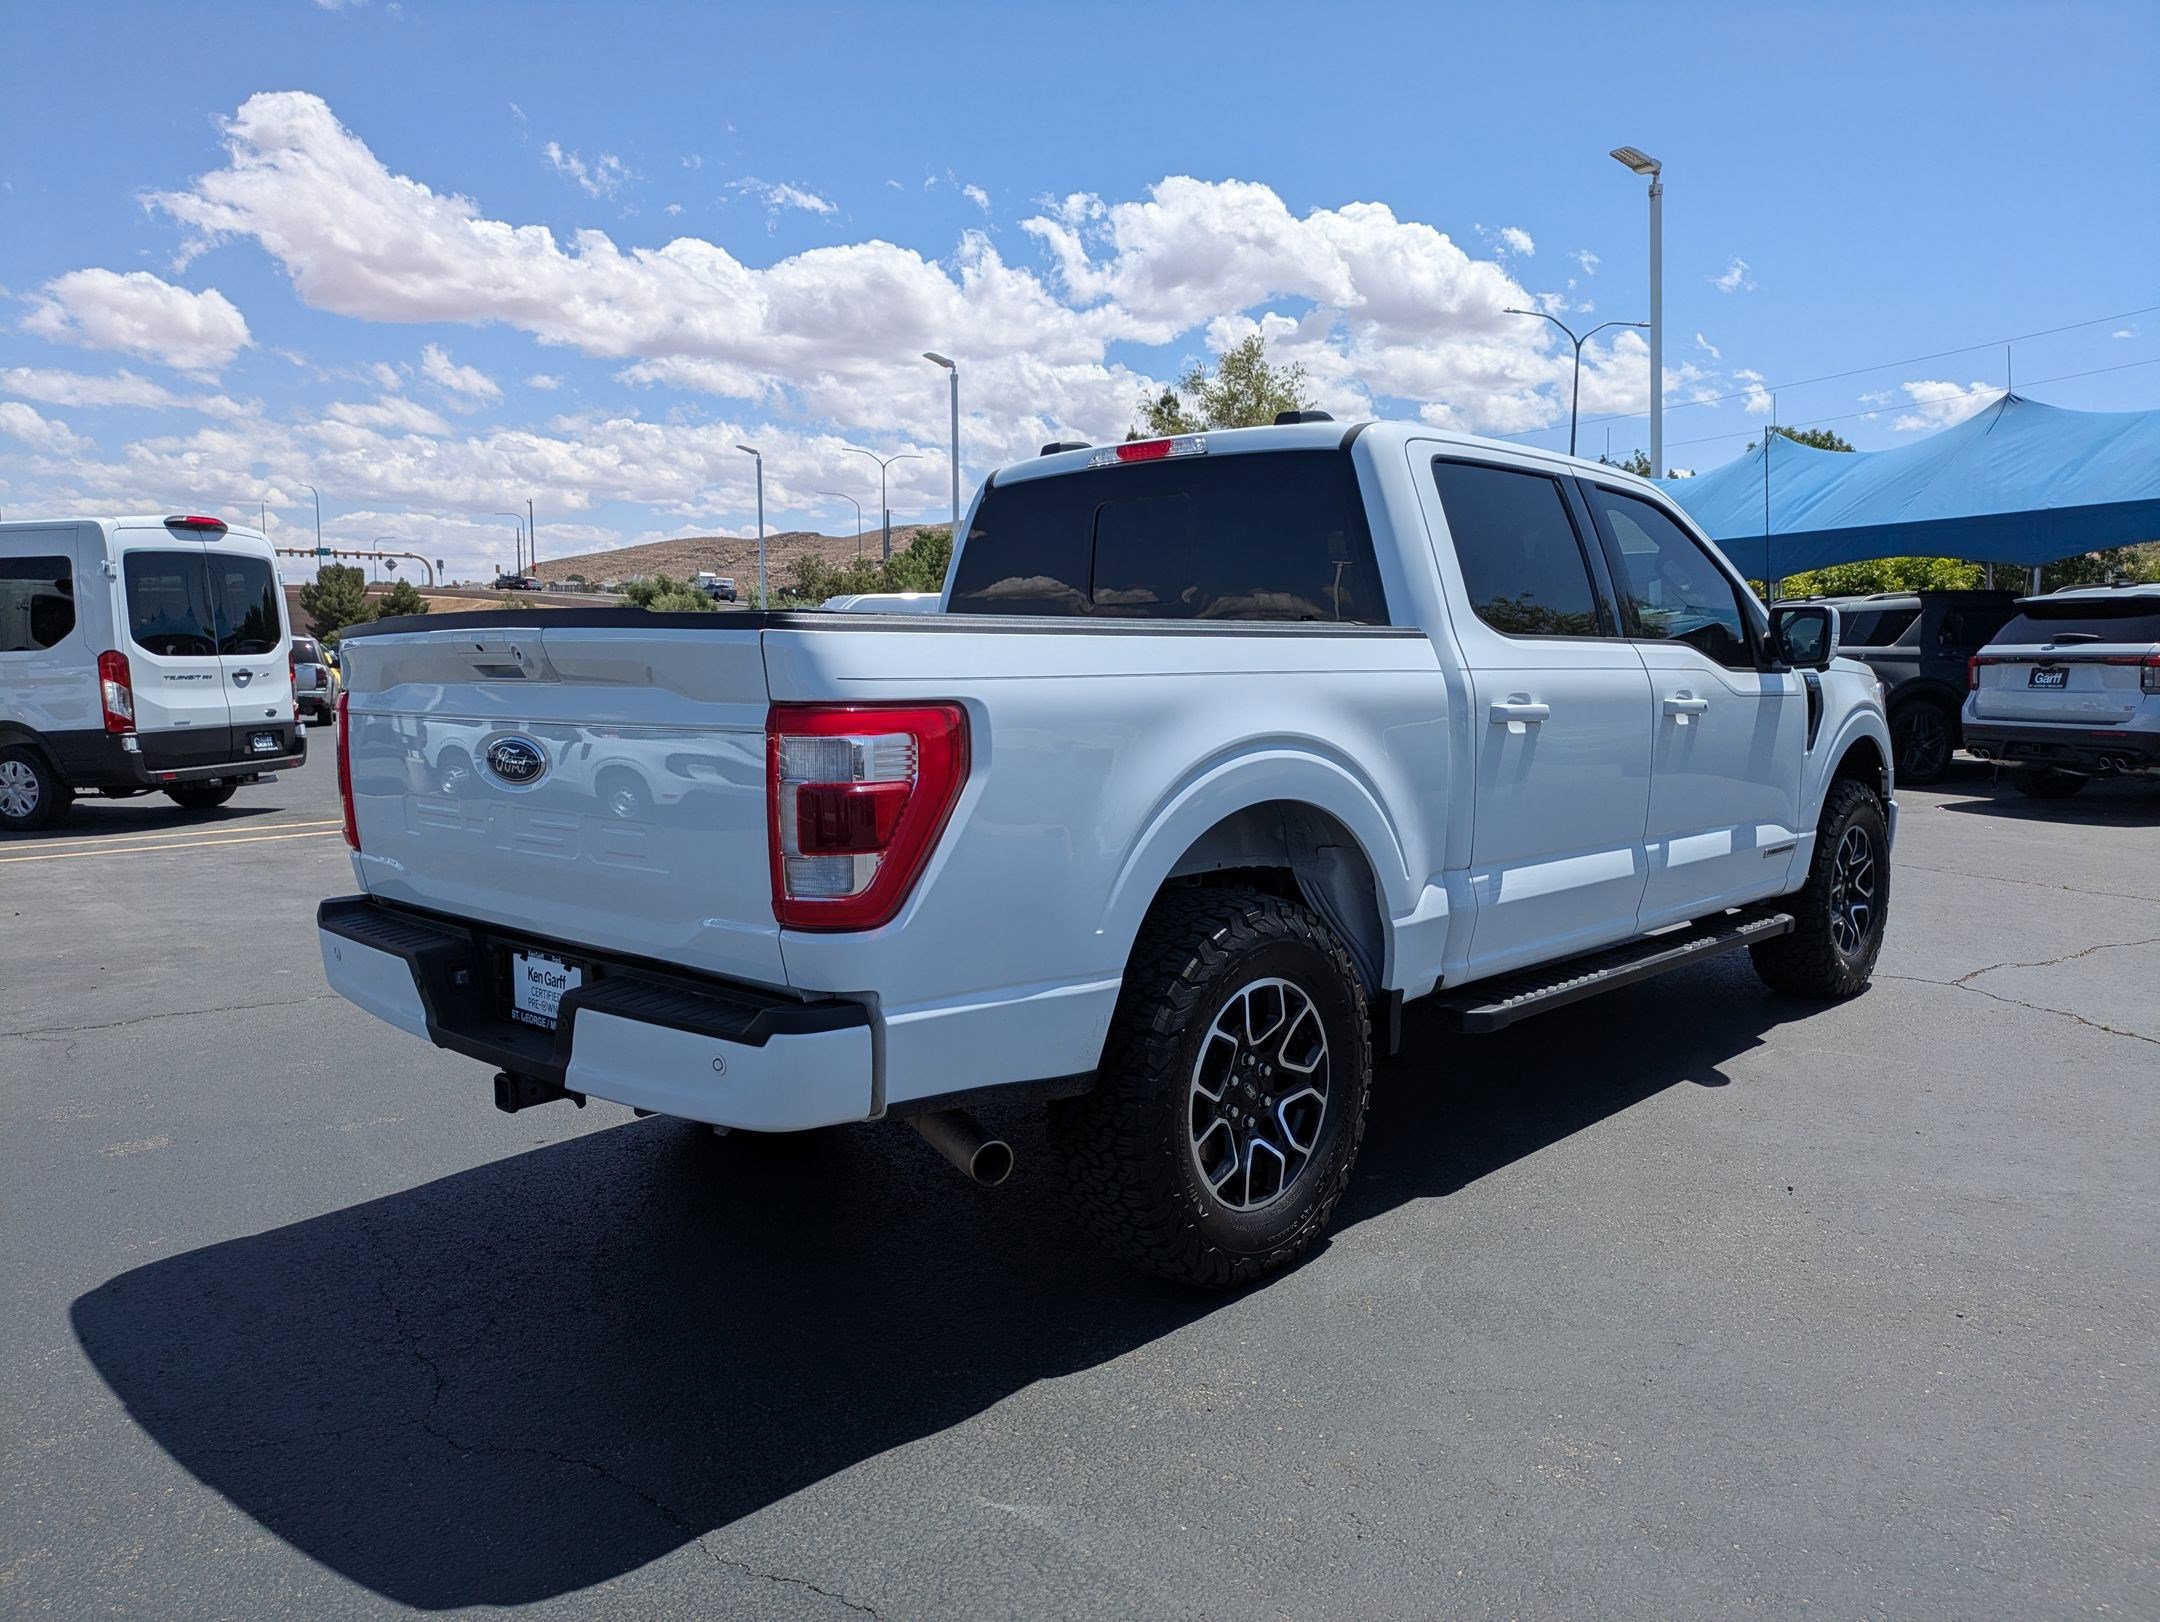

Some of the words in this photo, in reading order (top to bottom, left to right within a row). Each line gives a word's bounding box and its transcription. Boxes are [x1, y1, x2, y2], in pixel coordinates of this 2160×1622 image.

[2034, 672, 2063, 684] Garff
[494, 745, 531, 775] Ford
[403, 791, 670, 874] F-150
[528, 966, 543, 985] Ken
[544, 971, 567, 990] Garff
[521, 1012, 546, 1027] GEORGE
